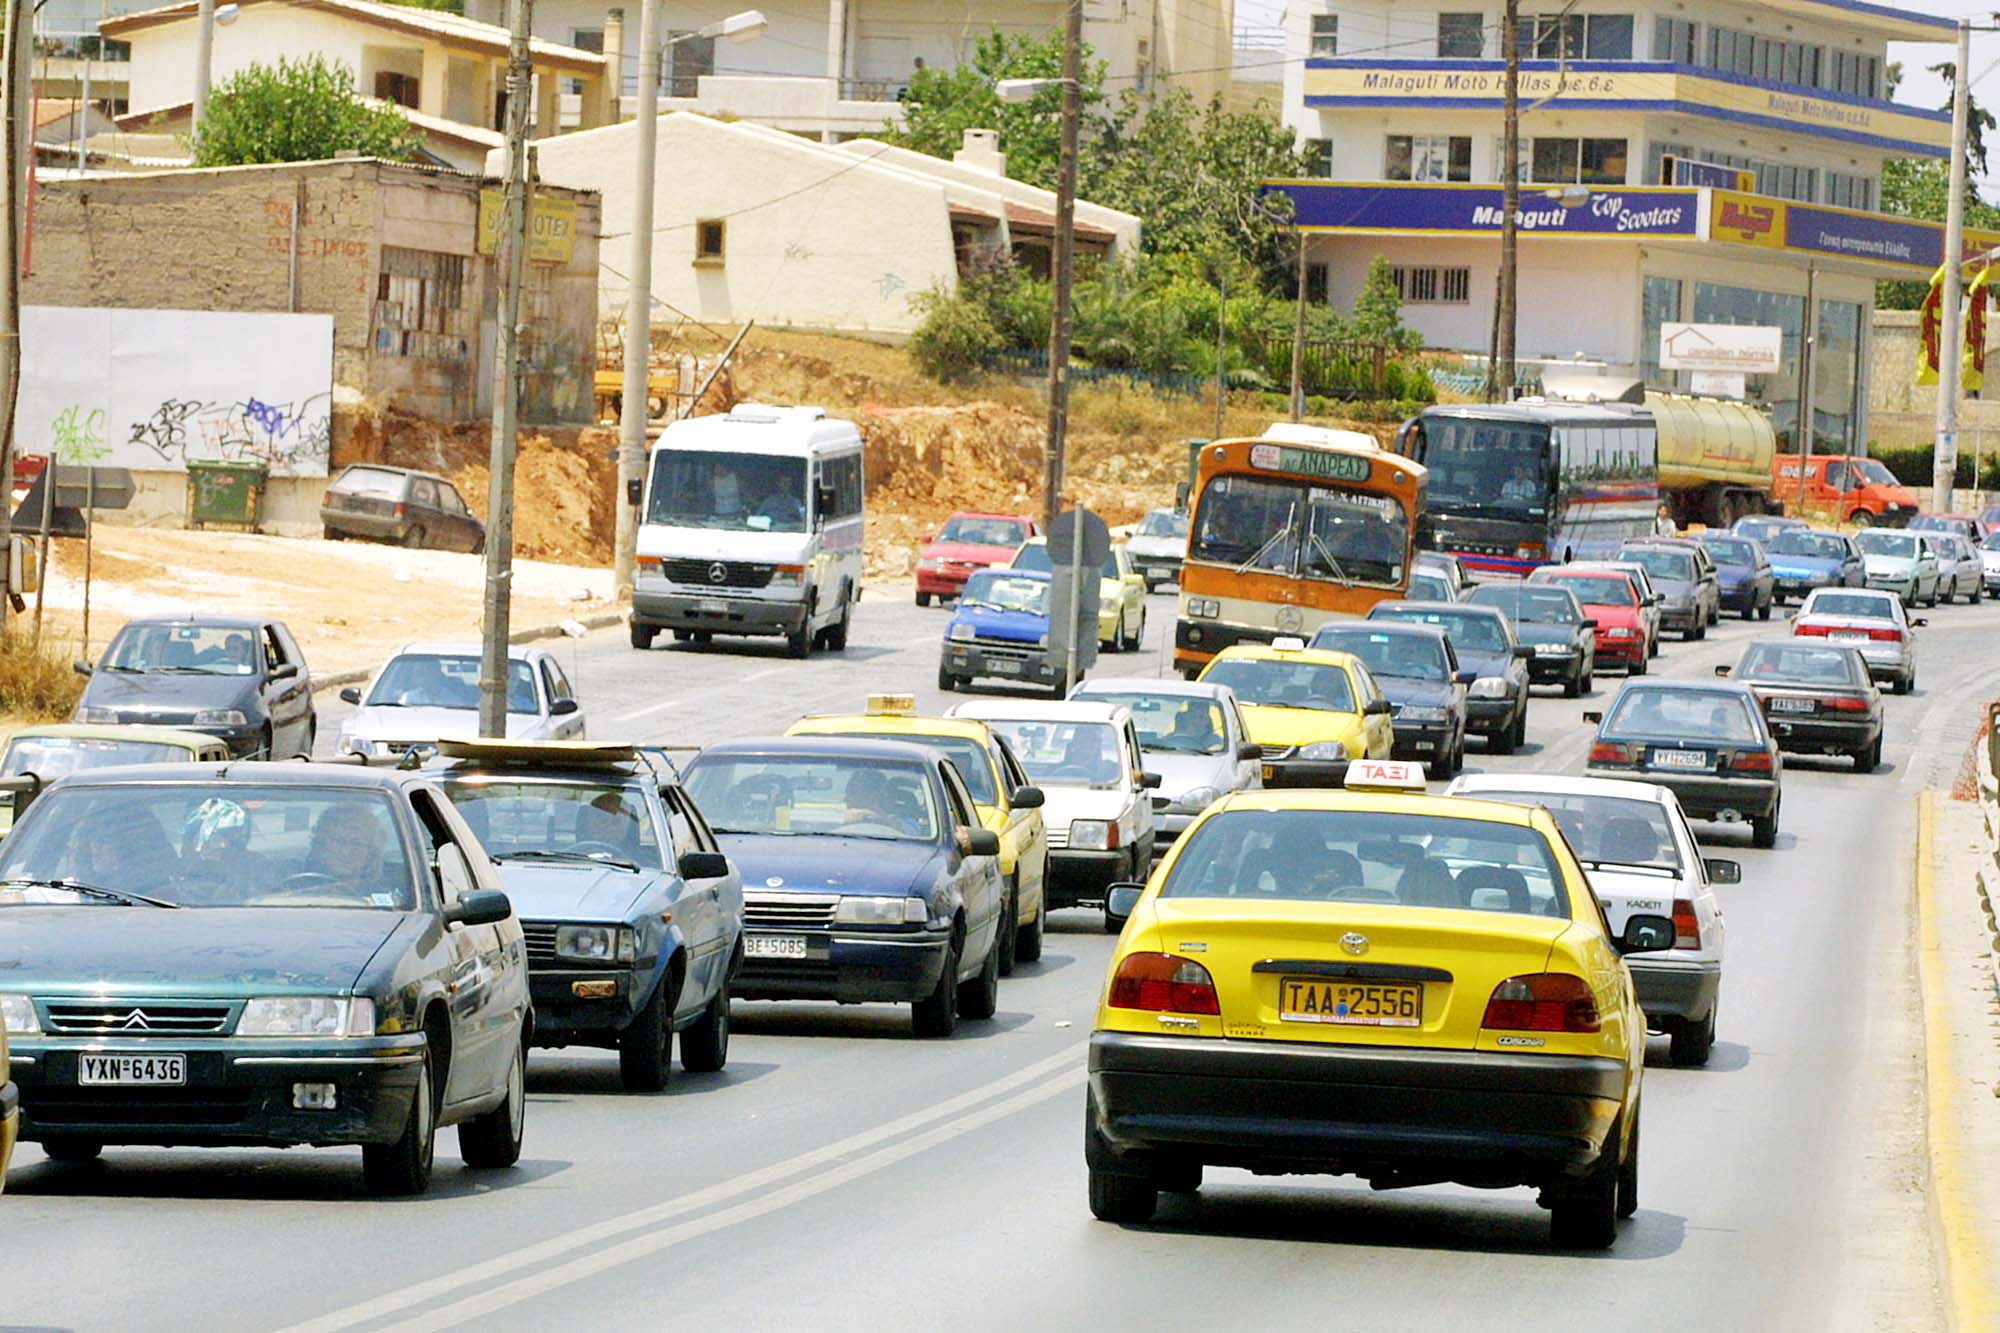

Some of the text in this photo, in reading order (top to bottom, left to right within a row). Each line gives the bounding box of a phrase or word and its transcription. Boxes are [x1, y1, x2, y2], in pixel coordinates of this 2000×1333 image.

[1363, 73, 1438, 92] Malaguti
[1495, 74, 1551, 91] Hllas
[1472, 194, 1683, 231] Maaguti Top Scooters
[1300, 452, 1363, 478] ΑΝΔΡΕΑΣ
